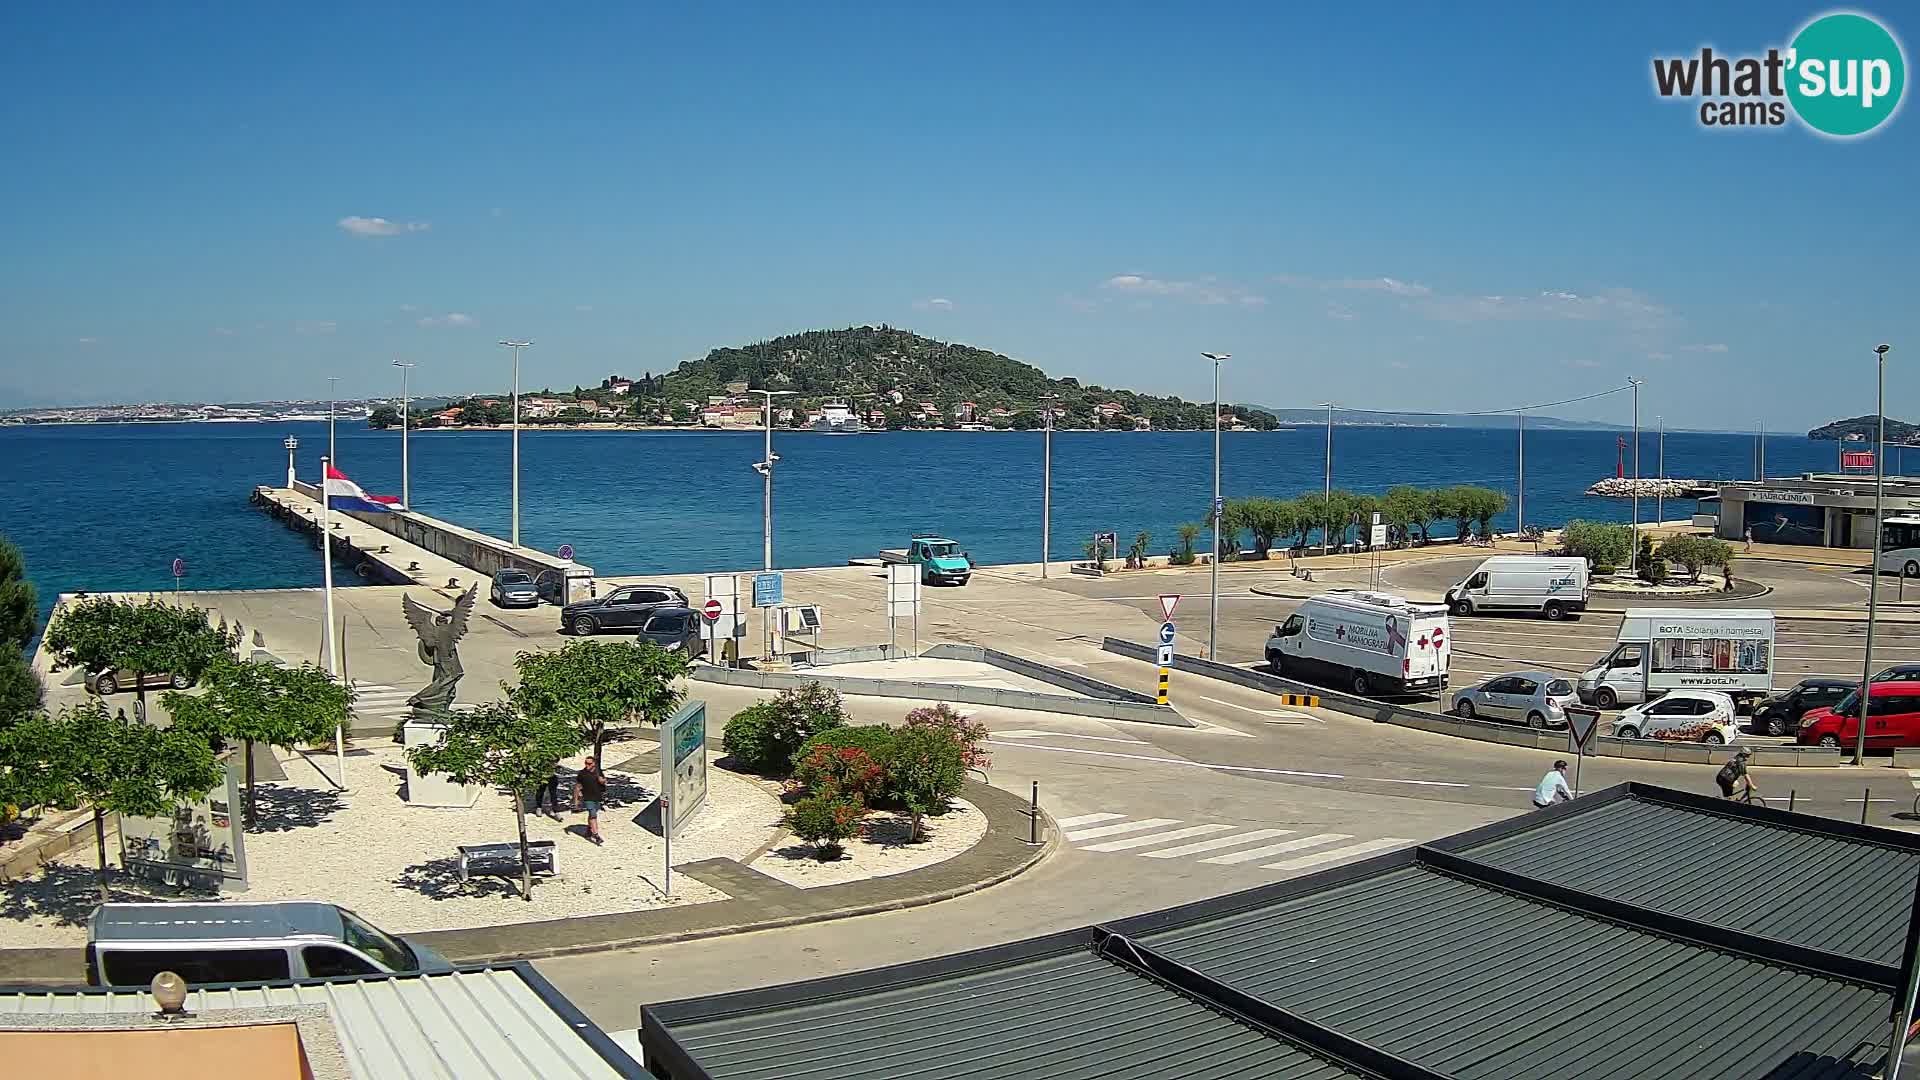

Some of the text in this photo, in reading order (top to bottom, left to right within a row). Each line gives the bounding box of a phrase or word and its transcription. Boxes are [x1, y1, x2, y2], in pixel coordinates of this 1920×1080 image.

[1348, 625, 1378, 637] MOBILNA
[1660, 626, 1683, 634] BOTA
[1680, 677, 1738, 685] www.bota.hr
